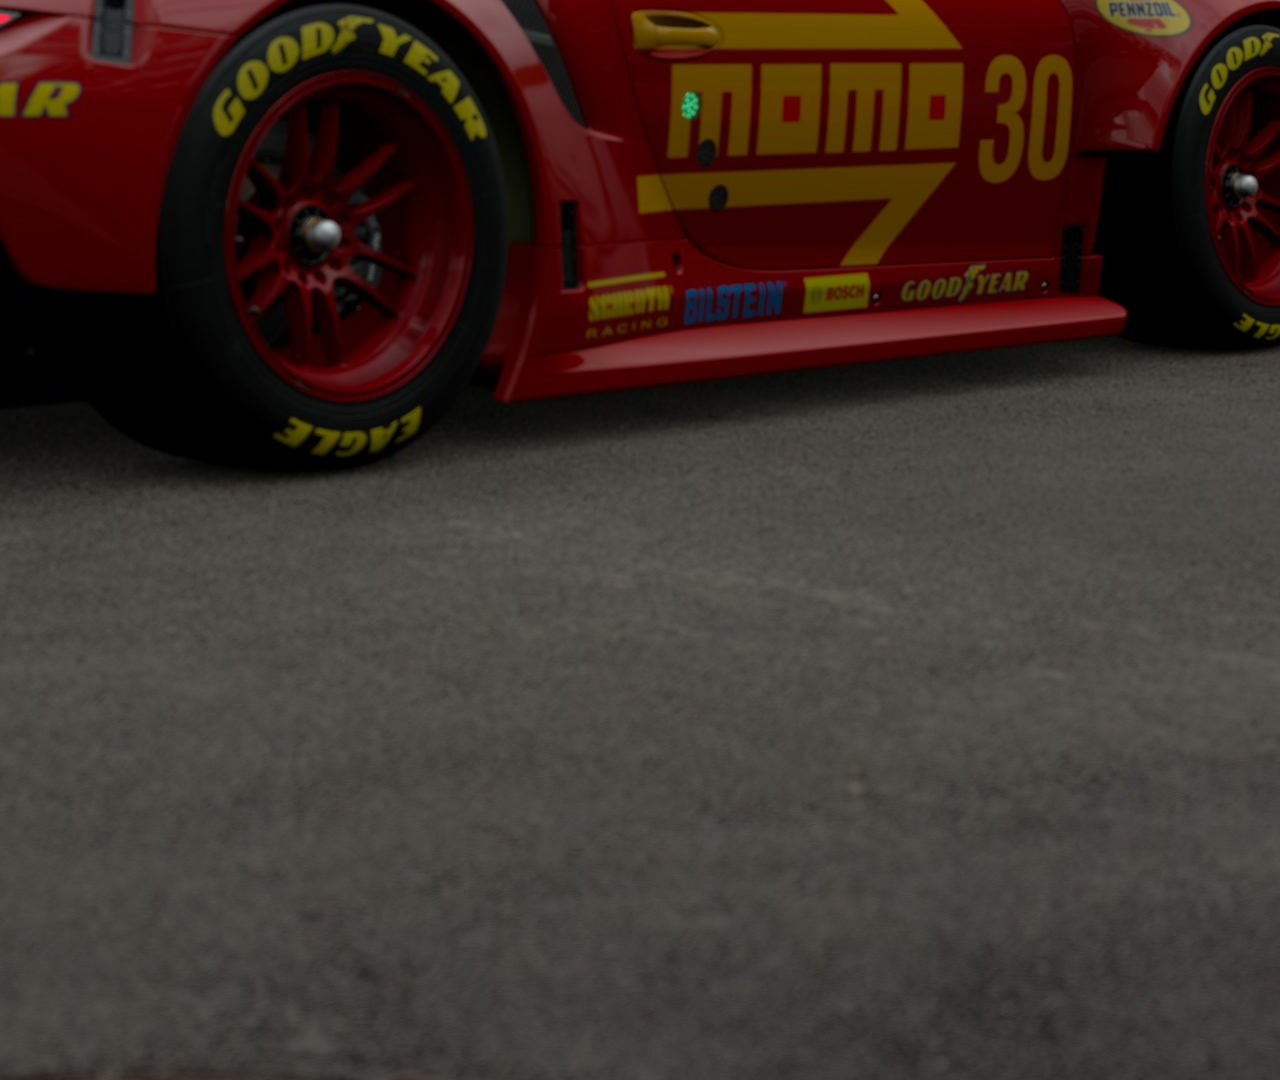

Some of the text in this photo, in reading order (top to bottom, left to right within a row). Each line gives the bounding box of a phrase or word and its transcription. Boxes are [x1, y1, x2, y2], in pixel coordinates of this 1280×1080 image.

[1108, 1, 1176, 17] PENNZOIL
[977, 53, 1075, 185] 30
[682, 279, 785, 327] BILSTEIN
[826, 283, 865, 302] BOSCH
[585, 315, 670, 341] RACING
[272, 404, 424, 458] EAGLE
